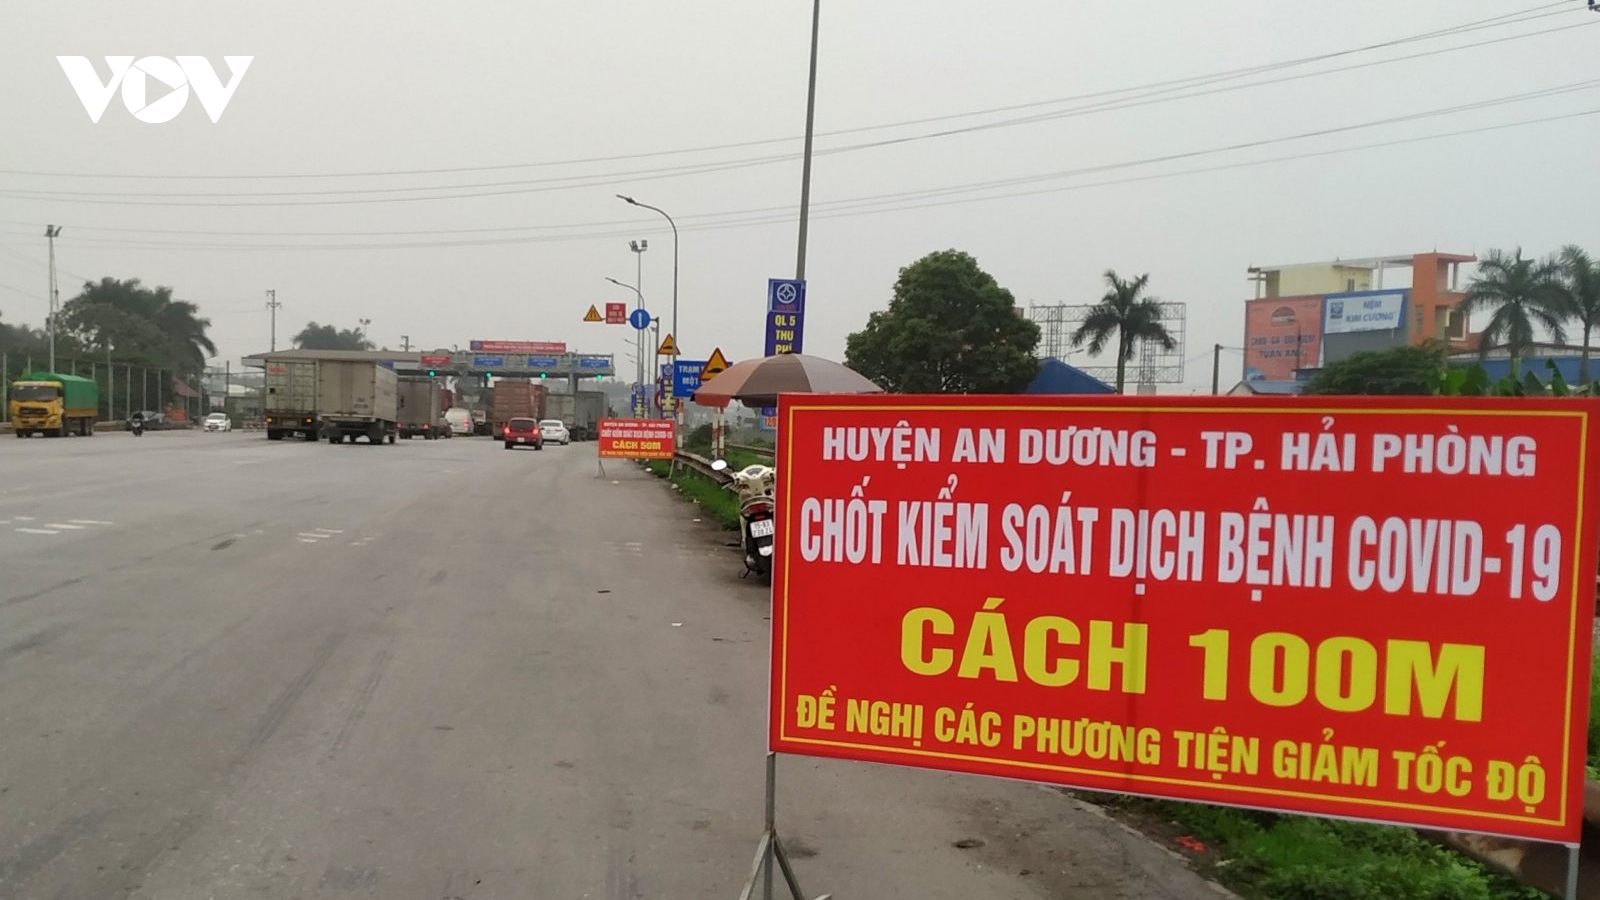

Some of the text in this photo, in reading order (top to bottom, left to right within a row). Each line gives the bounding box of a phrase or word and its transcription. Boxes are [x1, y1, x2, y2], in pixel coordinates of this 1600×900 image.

[774, 315, 796, 326] QL 5
[775, 330, 794, 341] THU
[612, 440, 661, 450] CÁCH 50M
[824, 420, 941, 469] HUYỆN
[952, 428, 1006, 463] AN
[1018, 425, 1157, 467] DƯƠNG
[1201, 431, 1265, 470] TP.
[1281, 416, 1356, 472] HẢI
[1372, 425, 1537, 477] PHÒNG
[801, 473, 1562, 602] CHỐT KIỂM SOÁT DỊCH BỆNH COVID-19
[901, 597, 1486, 722] CÁCH 100M
[796, 685, 1546, 814] ĐỀ NGHỊ CÁC PHƯƠNG TIỆN GIẢM TỐC ĐỘ
